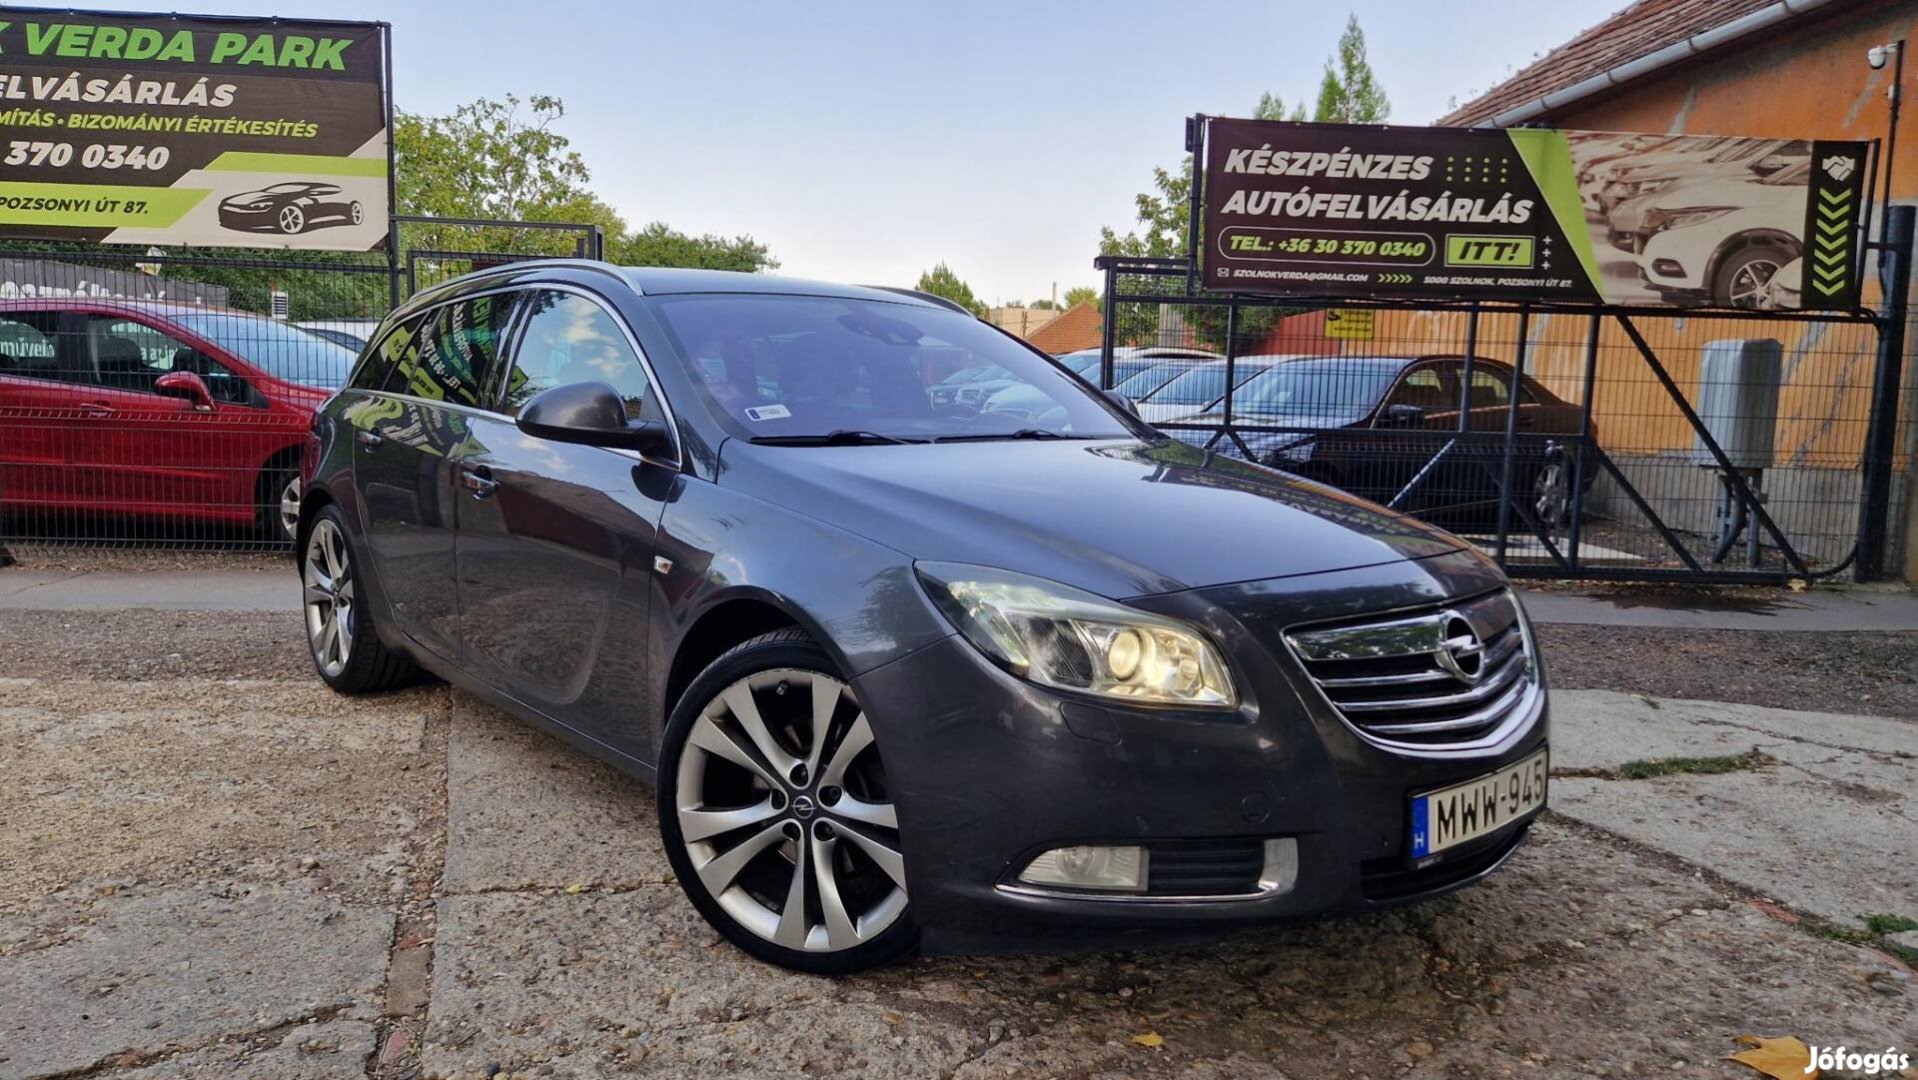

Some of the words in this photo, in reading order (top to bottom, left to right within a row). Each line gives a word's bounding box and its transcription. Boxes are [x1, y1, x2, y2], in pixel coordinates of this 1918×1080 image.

[26, 23, 195, 62] VERDA
[210, 32, 353, 71] PARK
[67, 112, 182, 132] BIZOMÁNYI
[184, 117, 319, 139] ÉRTÉKESÍTÉS
[4, 141, 73, 167] 370
[82, 144, 170, 171] 0340
[1224, 144, 1434, 181] KÉSZPÉNZES
[95, 196, 120, 213] ÚT
[123, 201, 148, 214] 87.
[1220, 186, 1534, 224] AUTÓFELVÁSÁRLÁS
[1230, 236, 1273, 251] TEL.:
[1279, 238, 1311, 253] +36
[1314, 239, 1339, 254] 30
[1341, 240, 1376, 255] 370
[1379, 241, 1426, 257] 0340
[1459, 240, 1520, 262] ITT!
[1233, 269, 1369, 282] SZOLNOKVERDA@GMAIL.COM
[1424, 276, 1448, 284] 5000
[1497, 278, 1544, 287] POZSONYI
[1437, 760, 1543, 844] MWW-945
[1414, 832, 1425, 849] H
